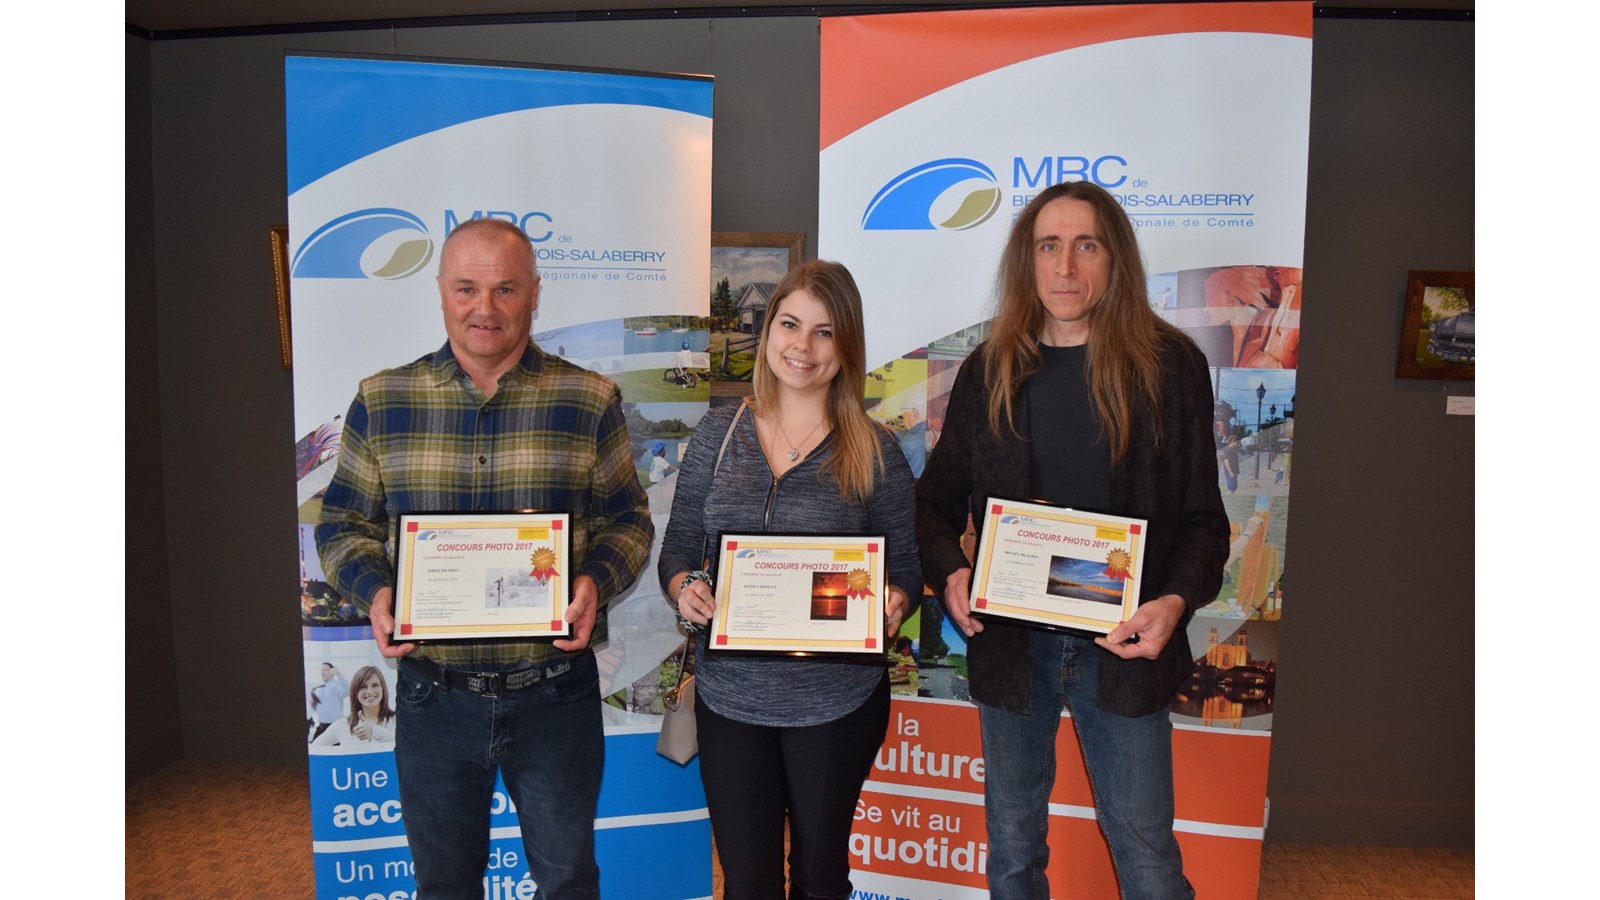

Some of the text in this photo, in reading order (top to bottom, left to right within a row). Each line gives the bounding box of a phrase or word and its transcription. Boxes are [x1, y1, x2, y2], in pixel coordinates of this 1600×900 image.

[1013, 155, 1148, 188] MRC de
[1182, 217, 1200, 227] de
[1207, 217, 1254, 227] Comté
[558, 234, 573, 243] de
[604, 272, 620, 281] de
[626, 272, 667, 281] Comté
[437, 542, 533, 552] CONCOURS PHOTO 2017
[1017, 529, 1110, 550] CONCOURS PHOTO 2017
[754, 561, 848, 571] CONCOURS PHOTO 2017
[897, 711, 920, 737] la
[874, 741, 986, 783] ulture
[332, 767, 388, 791] Une
[853, 798, 961, 834] Se vit au
[848, 831, 988, 875] quotidi
[335, 860, 374, 884] Un
[487, 847, 518, 869] de
